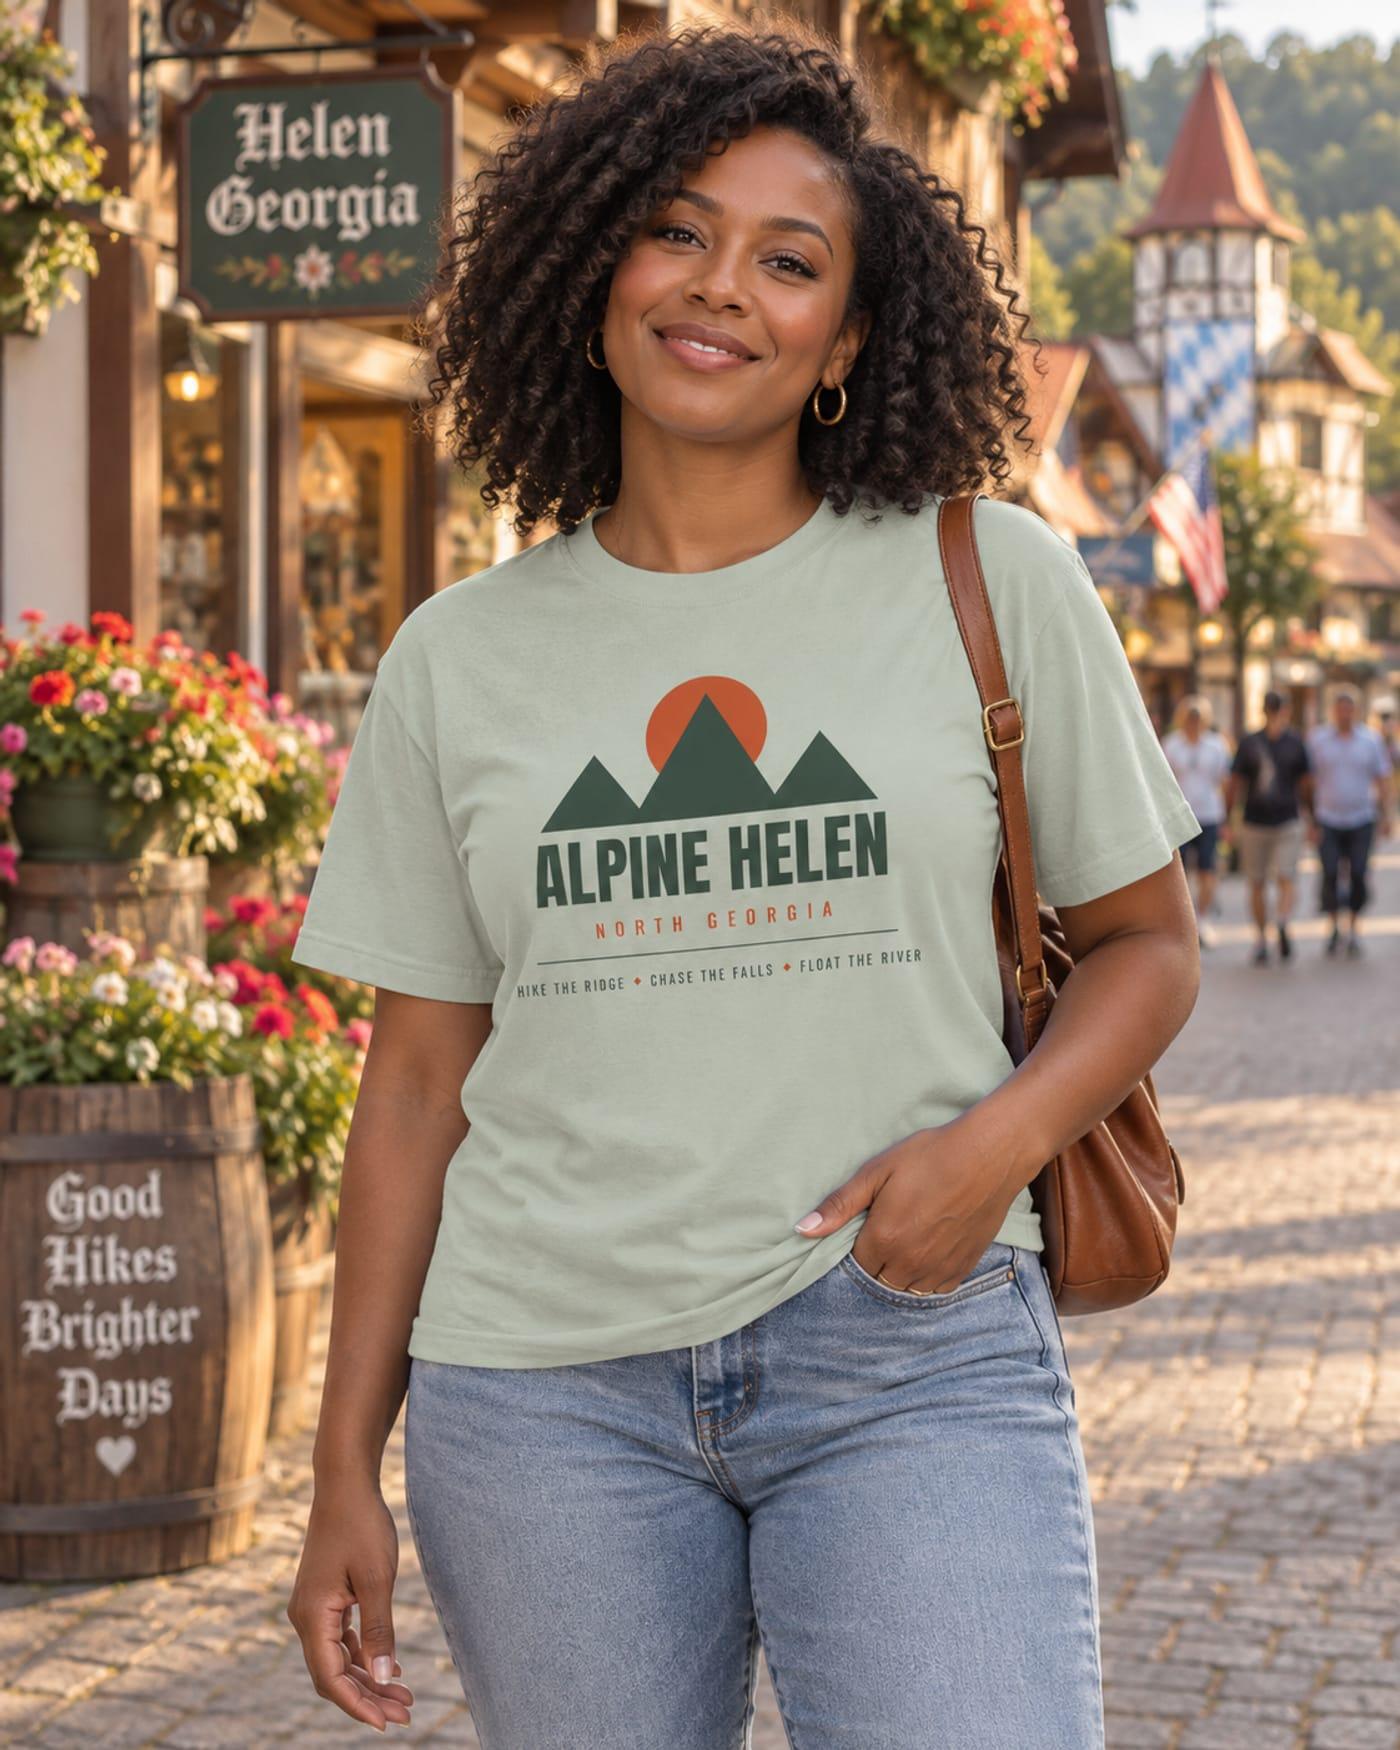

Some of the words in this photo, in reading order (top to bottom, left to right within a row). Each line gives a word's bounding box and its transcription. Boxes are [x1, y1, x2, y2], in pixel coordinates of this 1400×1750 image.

[233, 100, 391, 171] Helen
[206, 168, 420, 242] Georgia
[537, 830, 711, 908] ALPINE
[729, 811, 888, 891] HELEN
[595, 916, 684, 940] NORTH
[707, 900, 834, 929] GEORGIA
[517, 983, 547, 999] HIKE
[554, 981, 577, 995] THE
[584, 976, 625, 993] RIDGE
[650, 971, 693, 987] CHASE
[700, 968, 725, 983] THE
[733, 963, 774, 980] FALLS
[800, 956, 841, 973] FLOAT
[848, 953, 873, 968] THE
[881, 948, 922, 965] RIVER
[46, 1168, 163, 1233] Good
[42, 1233, 178, 1295] Hikes
[20, 1295, 200, 1360] Brighter
[56, 1366, 172, 1429] Days
